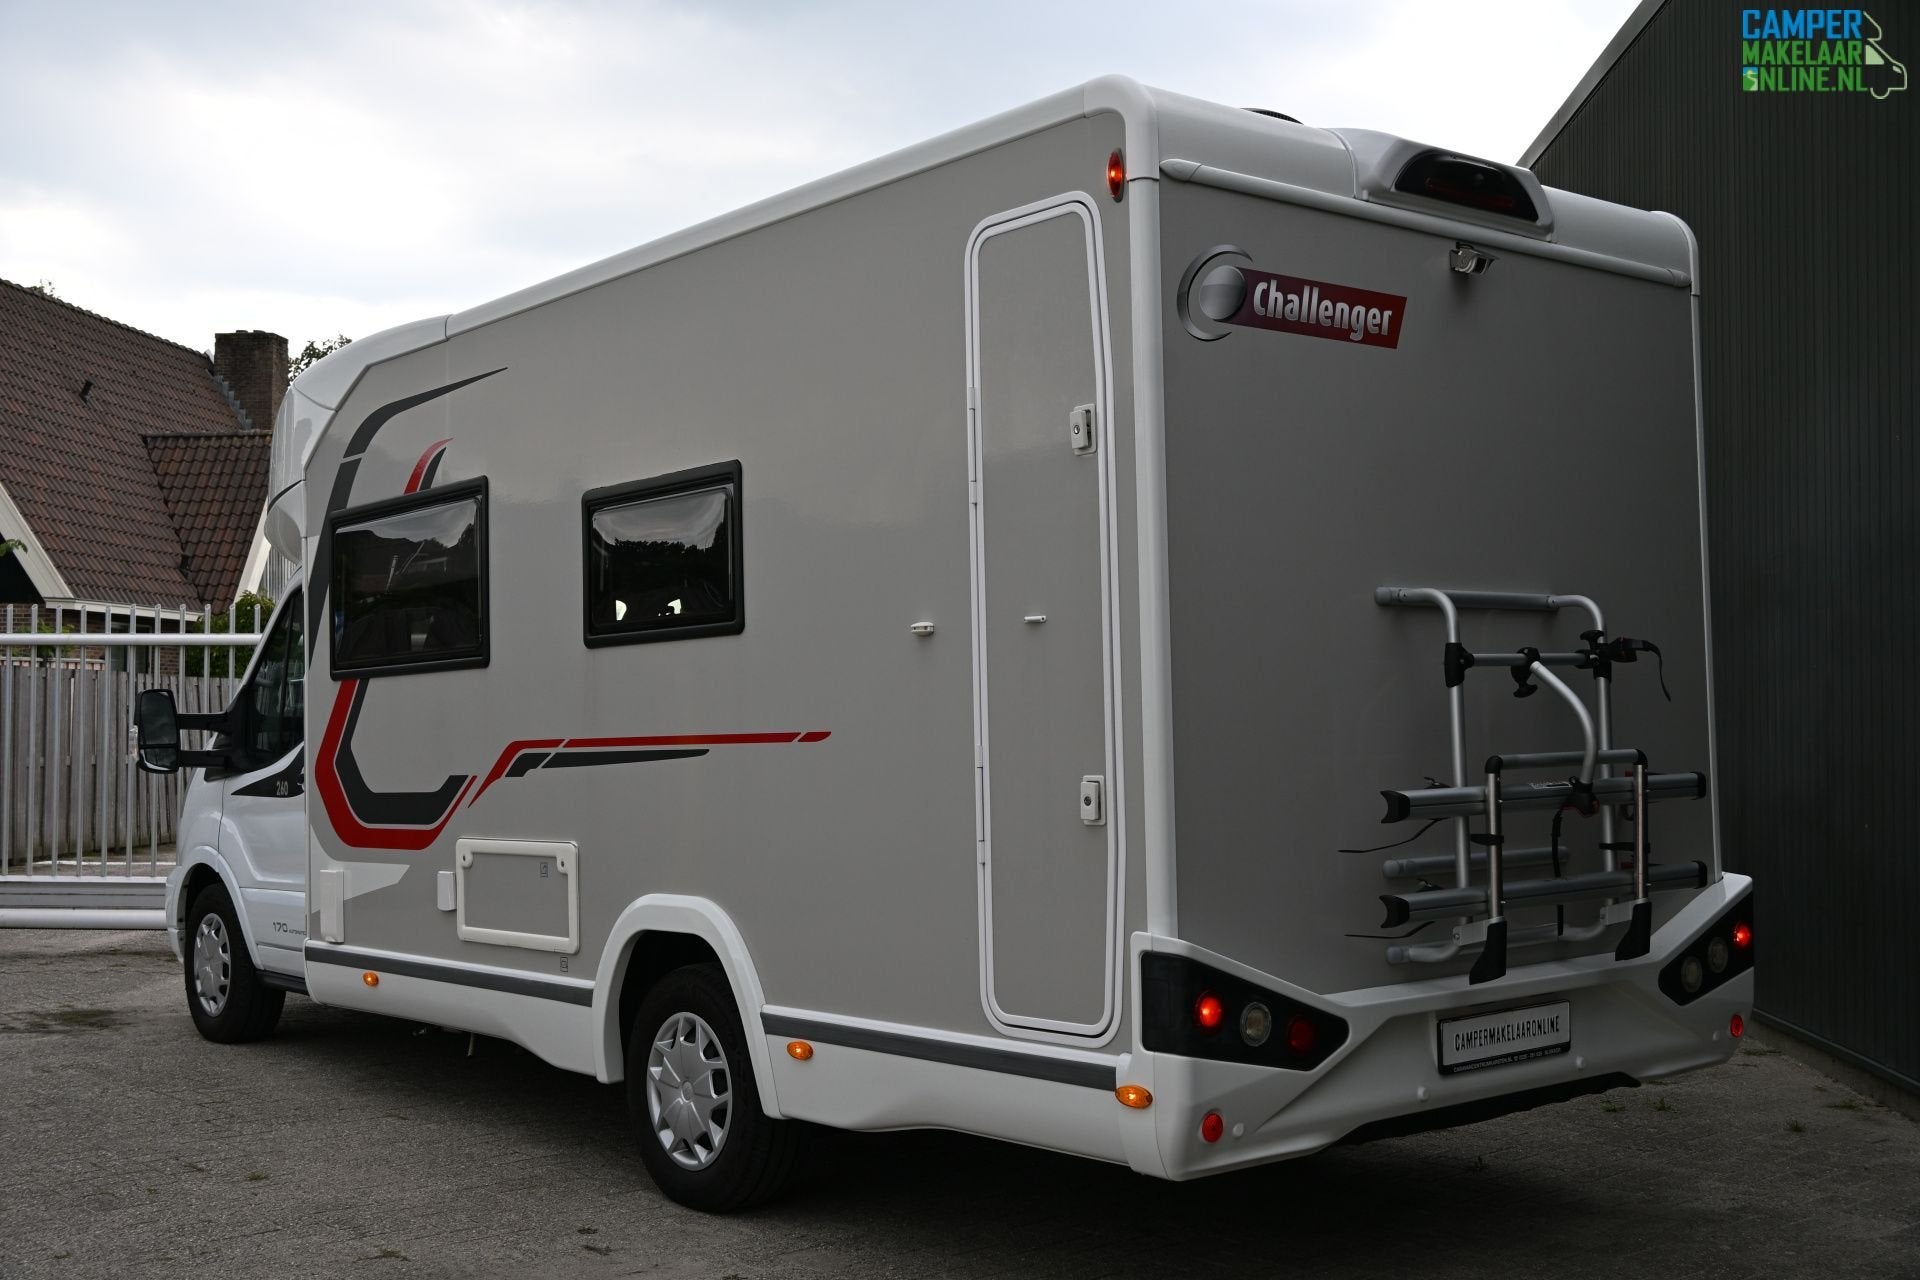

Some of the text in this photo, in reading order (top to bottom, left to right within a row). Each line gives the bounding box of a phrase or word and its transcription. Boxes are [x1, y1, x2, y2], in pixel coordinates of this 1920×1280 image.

[1253, 279, 1393, 341] Challenger
[276, 780, 289, 796] 260
[272, 921, 288, 933] 170
[1455, 1015, 1560, 1051] CAMPERMAKELAARONLINE
